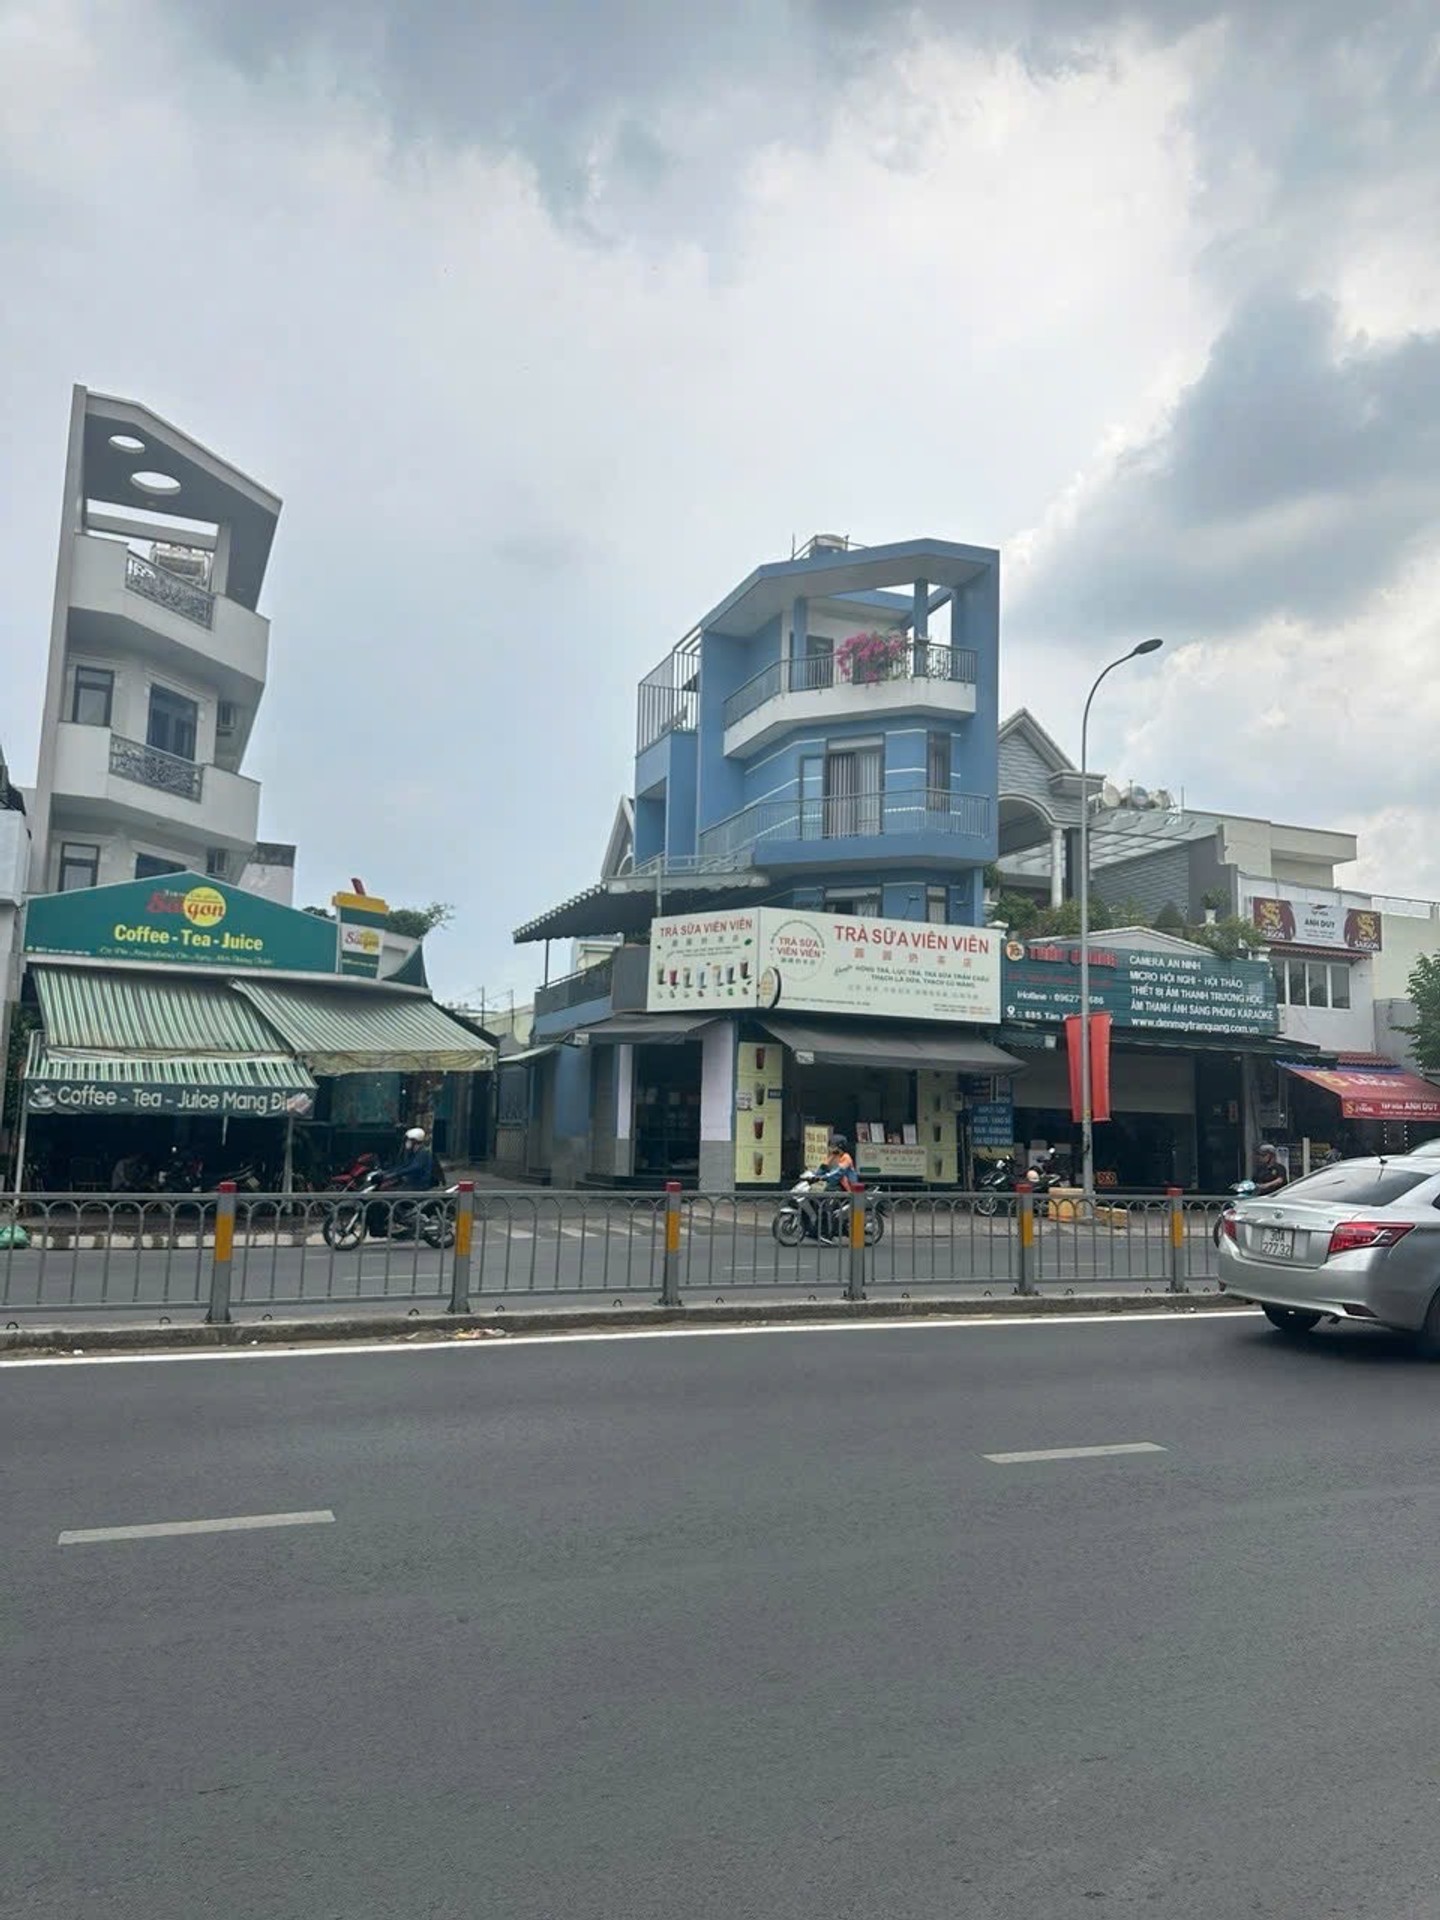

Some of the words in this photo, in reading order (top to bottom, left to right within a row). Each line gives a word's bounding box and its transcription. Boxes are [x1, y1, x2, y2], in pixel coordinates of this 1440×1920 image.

[660, 927, 677, 937] TRÀ
[680, 923, 701, 935] SỮA
[704, 921, 727, 933] VIÊN
[729, 919, 753, 931] VIÊN
[114, 924, 170, 944] Coffee
[181, 929, 211, 947] Tea
[222, 932, 264, 951] Juice
[779, 936, 797, 946] TRÀ
[834, 924, 868, 942] TRÀ
[872, 927, 908, 946] SỮA
[911, 930, 948, 949] VIÊN
[953, 934, 990, 954] VIÊN
[776, 945, 797, 956] VIÊN
[800, 947, 820, 958] VIÊN
[1129, 955, 1165, 967] CAMERA
[1167, 958, 1180, 968] AN
[1182, 960, 1201, 970] NINH
[1130, 970, 1158, 981] MICRO
[1131, 982, 1153, 996] THIẾT
[1181, 989, 1209, 1000] THANH
[1145, 1001, 1171, 1012] THANH
[1238, 1009, 1274, 1021] KARAOKE
[57, 1085, 117, 1106] Coffee
[133, 1089, 162, 1107] Tea
[177, 1090, 219, 1109] Juice
[222, 1093, 267, 1114] Mang
